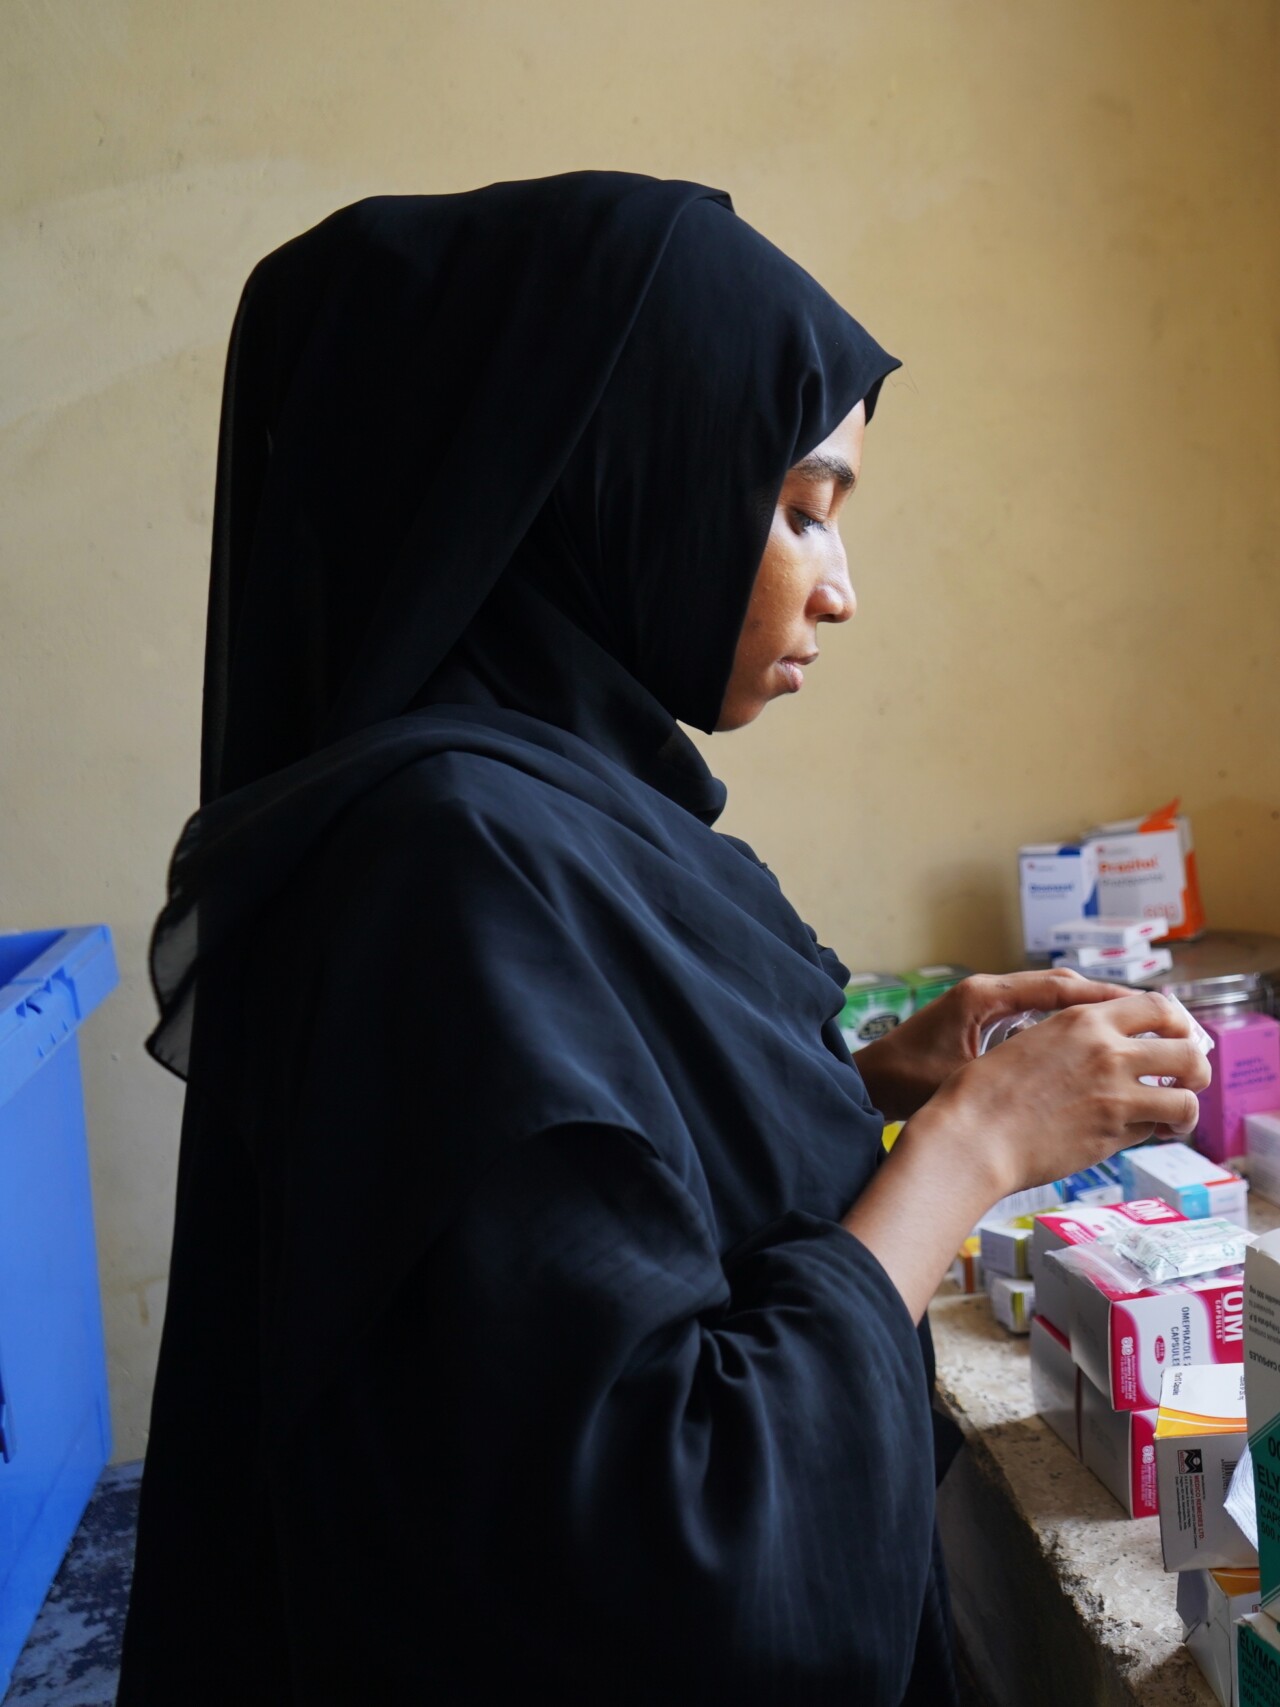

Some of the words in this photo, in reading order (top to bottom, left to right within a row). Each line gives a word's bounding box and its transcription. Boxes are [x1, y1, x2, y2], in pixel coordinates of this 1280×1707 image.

[1181, 1306, 1192, 1362] OMEPRAZOLE
[1249, 1350, 1278, 1372] CAPSULES
[1193, 1475, 1201, 1498] MEDICO
[1195, 1498, 1203, 1527] REMEDIES
